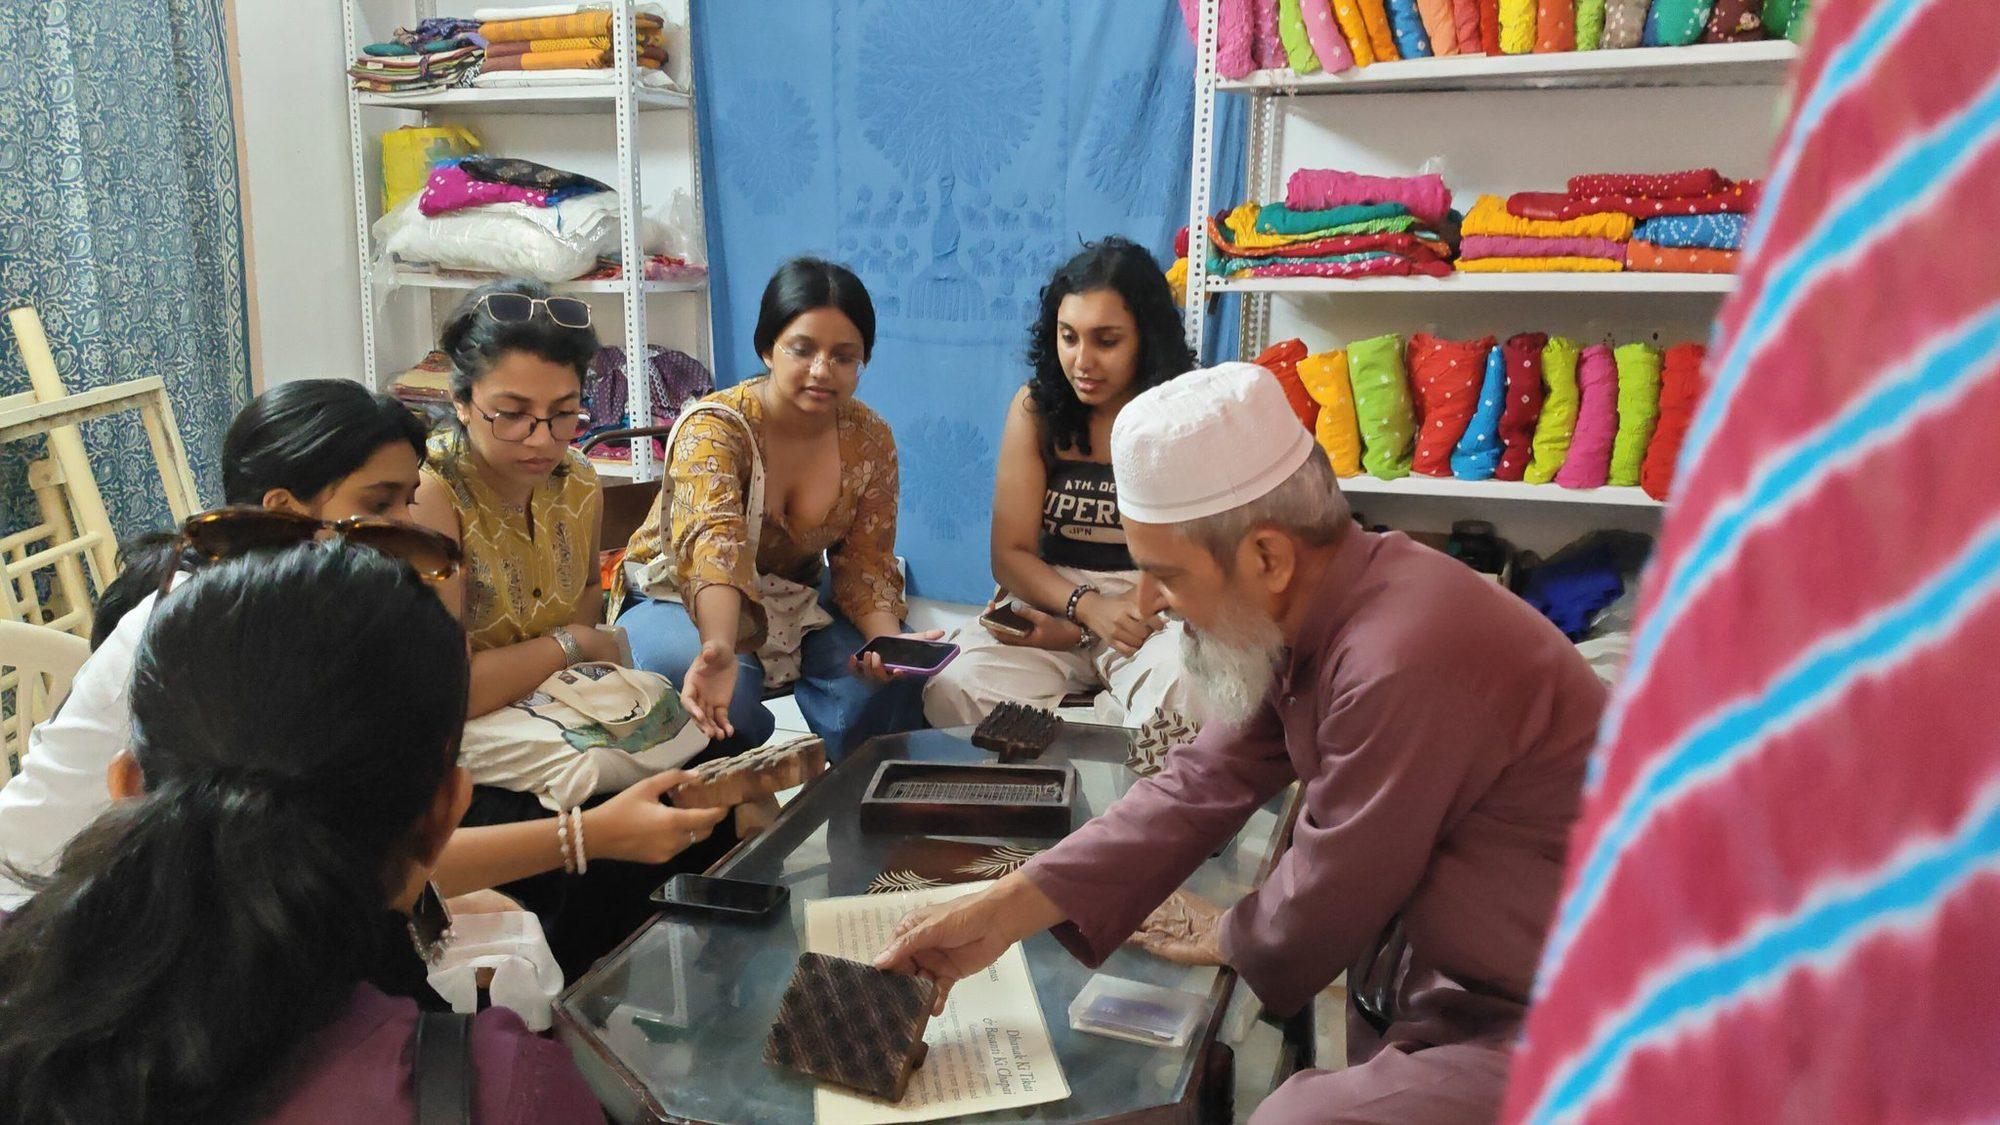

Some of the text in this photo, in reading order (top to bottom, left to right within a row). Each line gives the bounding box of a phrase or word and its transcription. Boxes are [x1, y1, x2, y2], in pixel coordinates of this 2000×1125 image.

[1064, 479, 1095, 491] ATH.
[1043, 489, 1121, 525] UPER
[1069, 526, 1092, 536] JPN
[985, 1027, 1004, 1055] Basanti
[993, 1056, 1008, 1066] Ki
[1016, 1061, 1031, 1071] Ki
